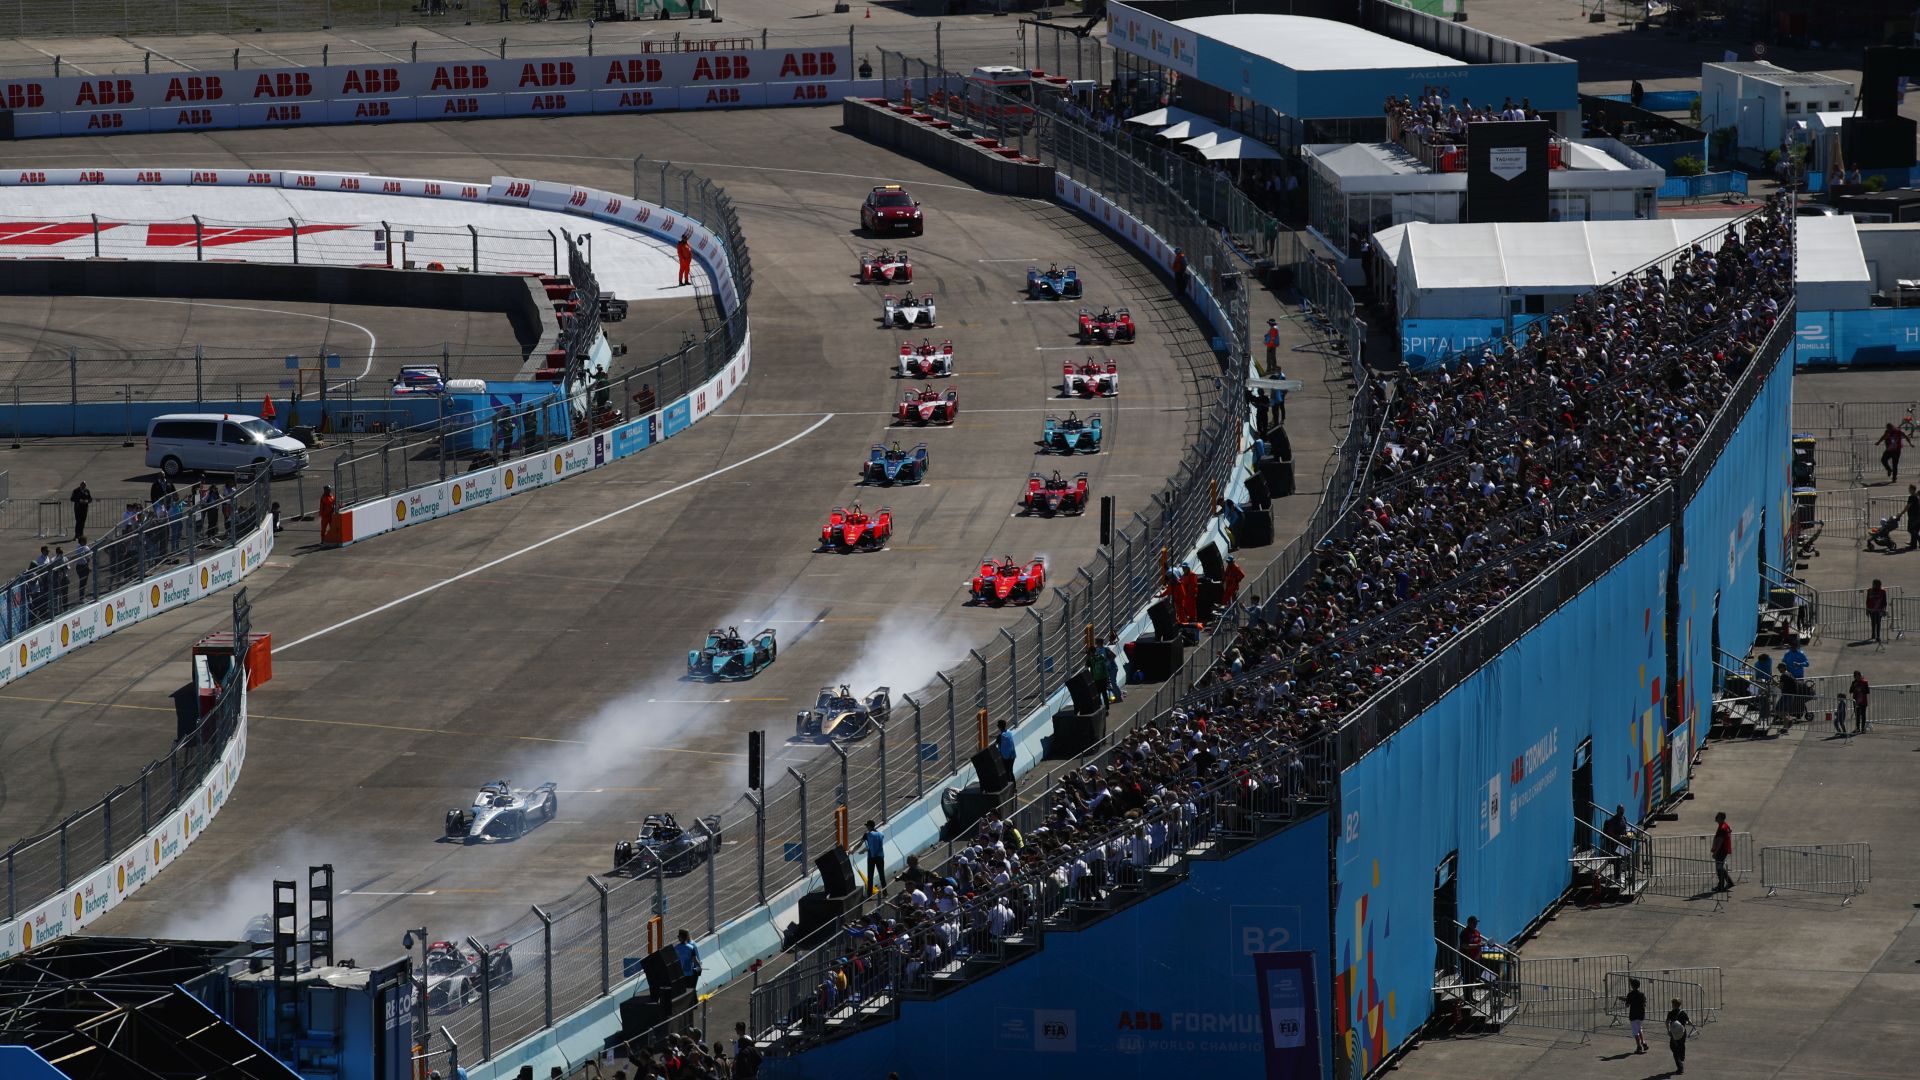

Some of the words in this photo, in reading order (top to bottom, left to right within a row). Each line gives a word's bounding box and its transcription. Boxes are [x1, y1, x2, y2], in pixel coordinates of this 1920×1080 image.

[606, 59, 662, 84] ABB
[693, 56, 750, 81] ABB
[780, 52, 837, 78] ABB
[342, 68, 400, 94] ABB
[431, 65, 488, 90] ABB
[519, 62, 576, 88] ABB
[1406, 71, 1468, 80] JAGUAR
[76, 80, 134, 106] ABB
[165, 76, 223, 102] ABB
[254, 72, 312, 98] ABB
[793, 85, 827, 100] ABB
[0, 84, 44, 109] BB
[531, 95, 566, 110] ABB
[619, 92, 654, 107] ABB
[706, 88, 740, 104] ABB
[266, 105, 302, 121] ABB
[355, 102, 390, 117] ABB
[444, 98, 478, 113] ABB
[88, 113, 123, 129] ABB
[177, 109, 212, 125] ABB
[20, 172, 46, 183] ABB
[80, 172, 104, 182] ABB
[137, 171, 162, 182] ABB
[194, 172, 217, 183] ABB
[248, 173, 272, 184] ABB
[297, 176, 316, 187] ABB
[340, 178, 360, 189] ABB
[383, 181, 401, 193] ABB
[425, 183, 441, 195] ABB
[462, 187, 478, 198] ABB
[505, 182, 531, 198] ABB
[569, 190, 588, 206] ABB
[605, 198, 621, 213] ABB
[636, 206, 651, 222] ABB
[697, 392, 705, 414] ABB
[566, 450, 574, 460] Shell
[518, 464, 527, 474] Shell
[565, 456, 589, 471] Recharge
[466, 479, 476, 490] Shell
[517, 470, 544, 487] Recharge
[410, 495, 421, 505] Shell
[466, 486, 493, 502] Recharge
[410, 501, 440, 518] Recharge
[212, 567, 232, 585] Recharge
[164, 580, 173, 590] Shell
[164, 586, 190, 604] Recharge
[117, 600, 126, 610] Shell
[117, 605, 141, 624] Recharge
[72, 619, 81, 629] Shell
[72, 624, 95, 643] Recharge
[30, 639, 38, 649] Shell
[30, 644, 52, 662] Recharge
[1510, 754, 1523, 788] ABB
[1525, 731, 1552, 778] FORMULA
[1553, 726, 1558, 752] E
[1346, 811, 1358, 844] B2
[127, 864, 147, 886] Recharge
[85, 884, 94, 898] Shell
[85, 892, 108, 914] Recharge
[36, 912, 46, 927] Shell
[36, 920, 63, 944] Recharge
[1242, 926, 1290, 955] B2
[386, 994, 410, 1020] RECO
[1117, 1011, 1163, 1030] ABB
[1281, 1022, 1298, 1033] FIA
[1044, 1024, 1067, 1036] FIA
[1149, 1040, 1194, 1050] WORLD
